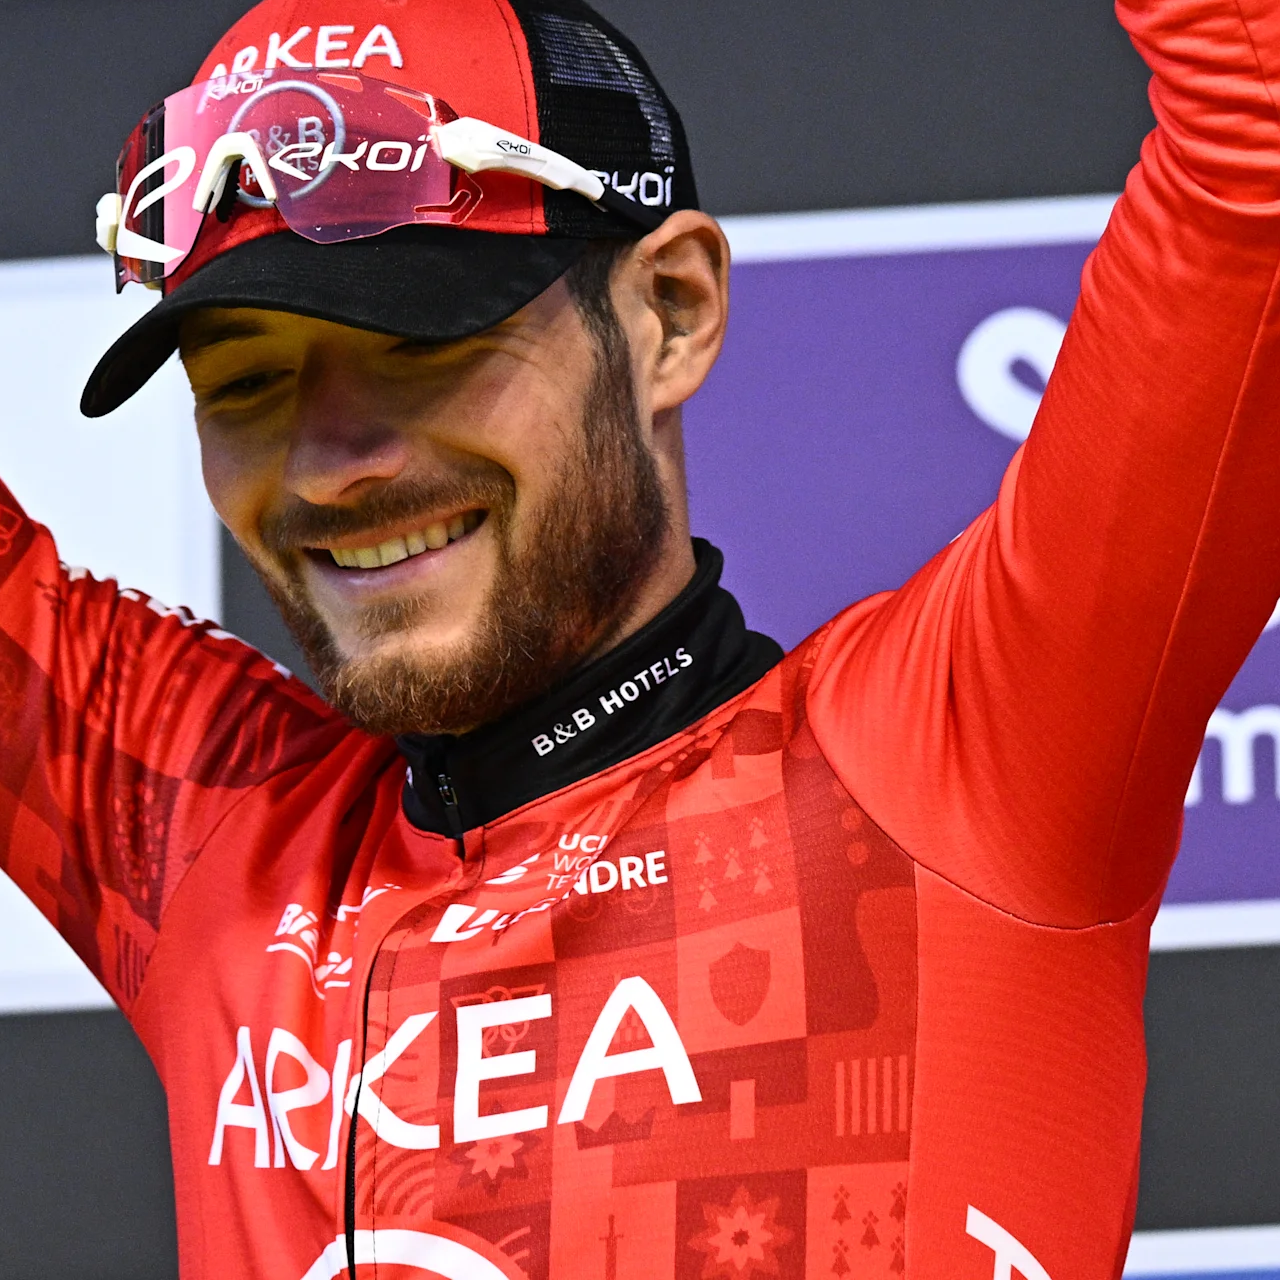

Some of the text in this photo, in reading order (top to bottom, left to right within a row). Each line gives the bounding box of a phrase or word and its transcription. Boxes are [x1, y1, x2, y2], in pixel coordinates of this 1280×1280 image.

[196, 24, 404, 114] ARKEA
[532, 647, 693, 757] B&B HOTELS
[558, 833, 609, 853] UCI
[207, 976, 702, 1171] ARKEA
